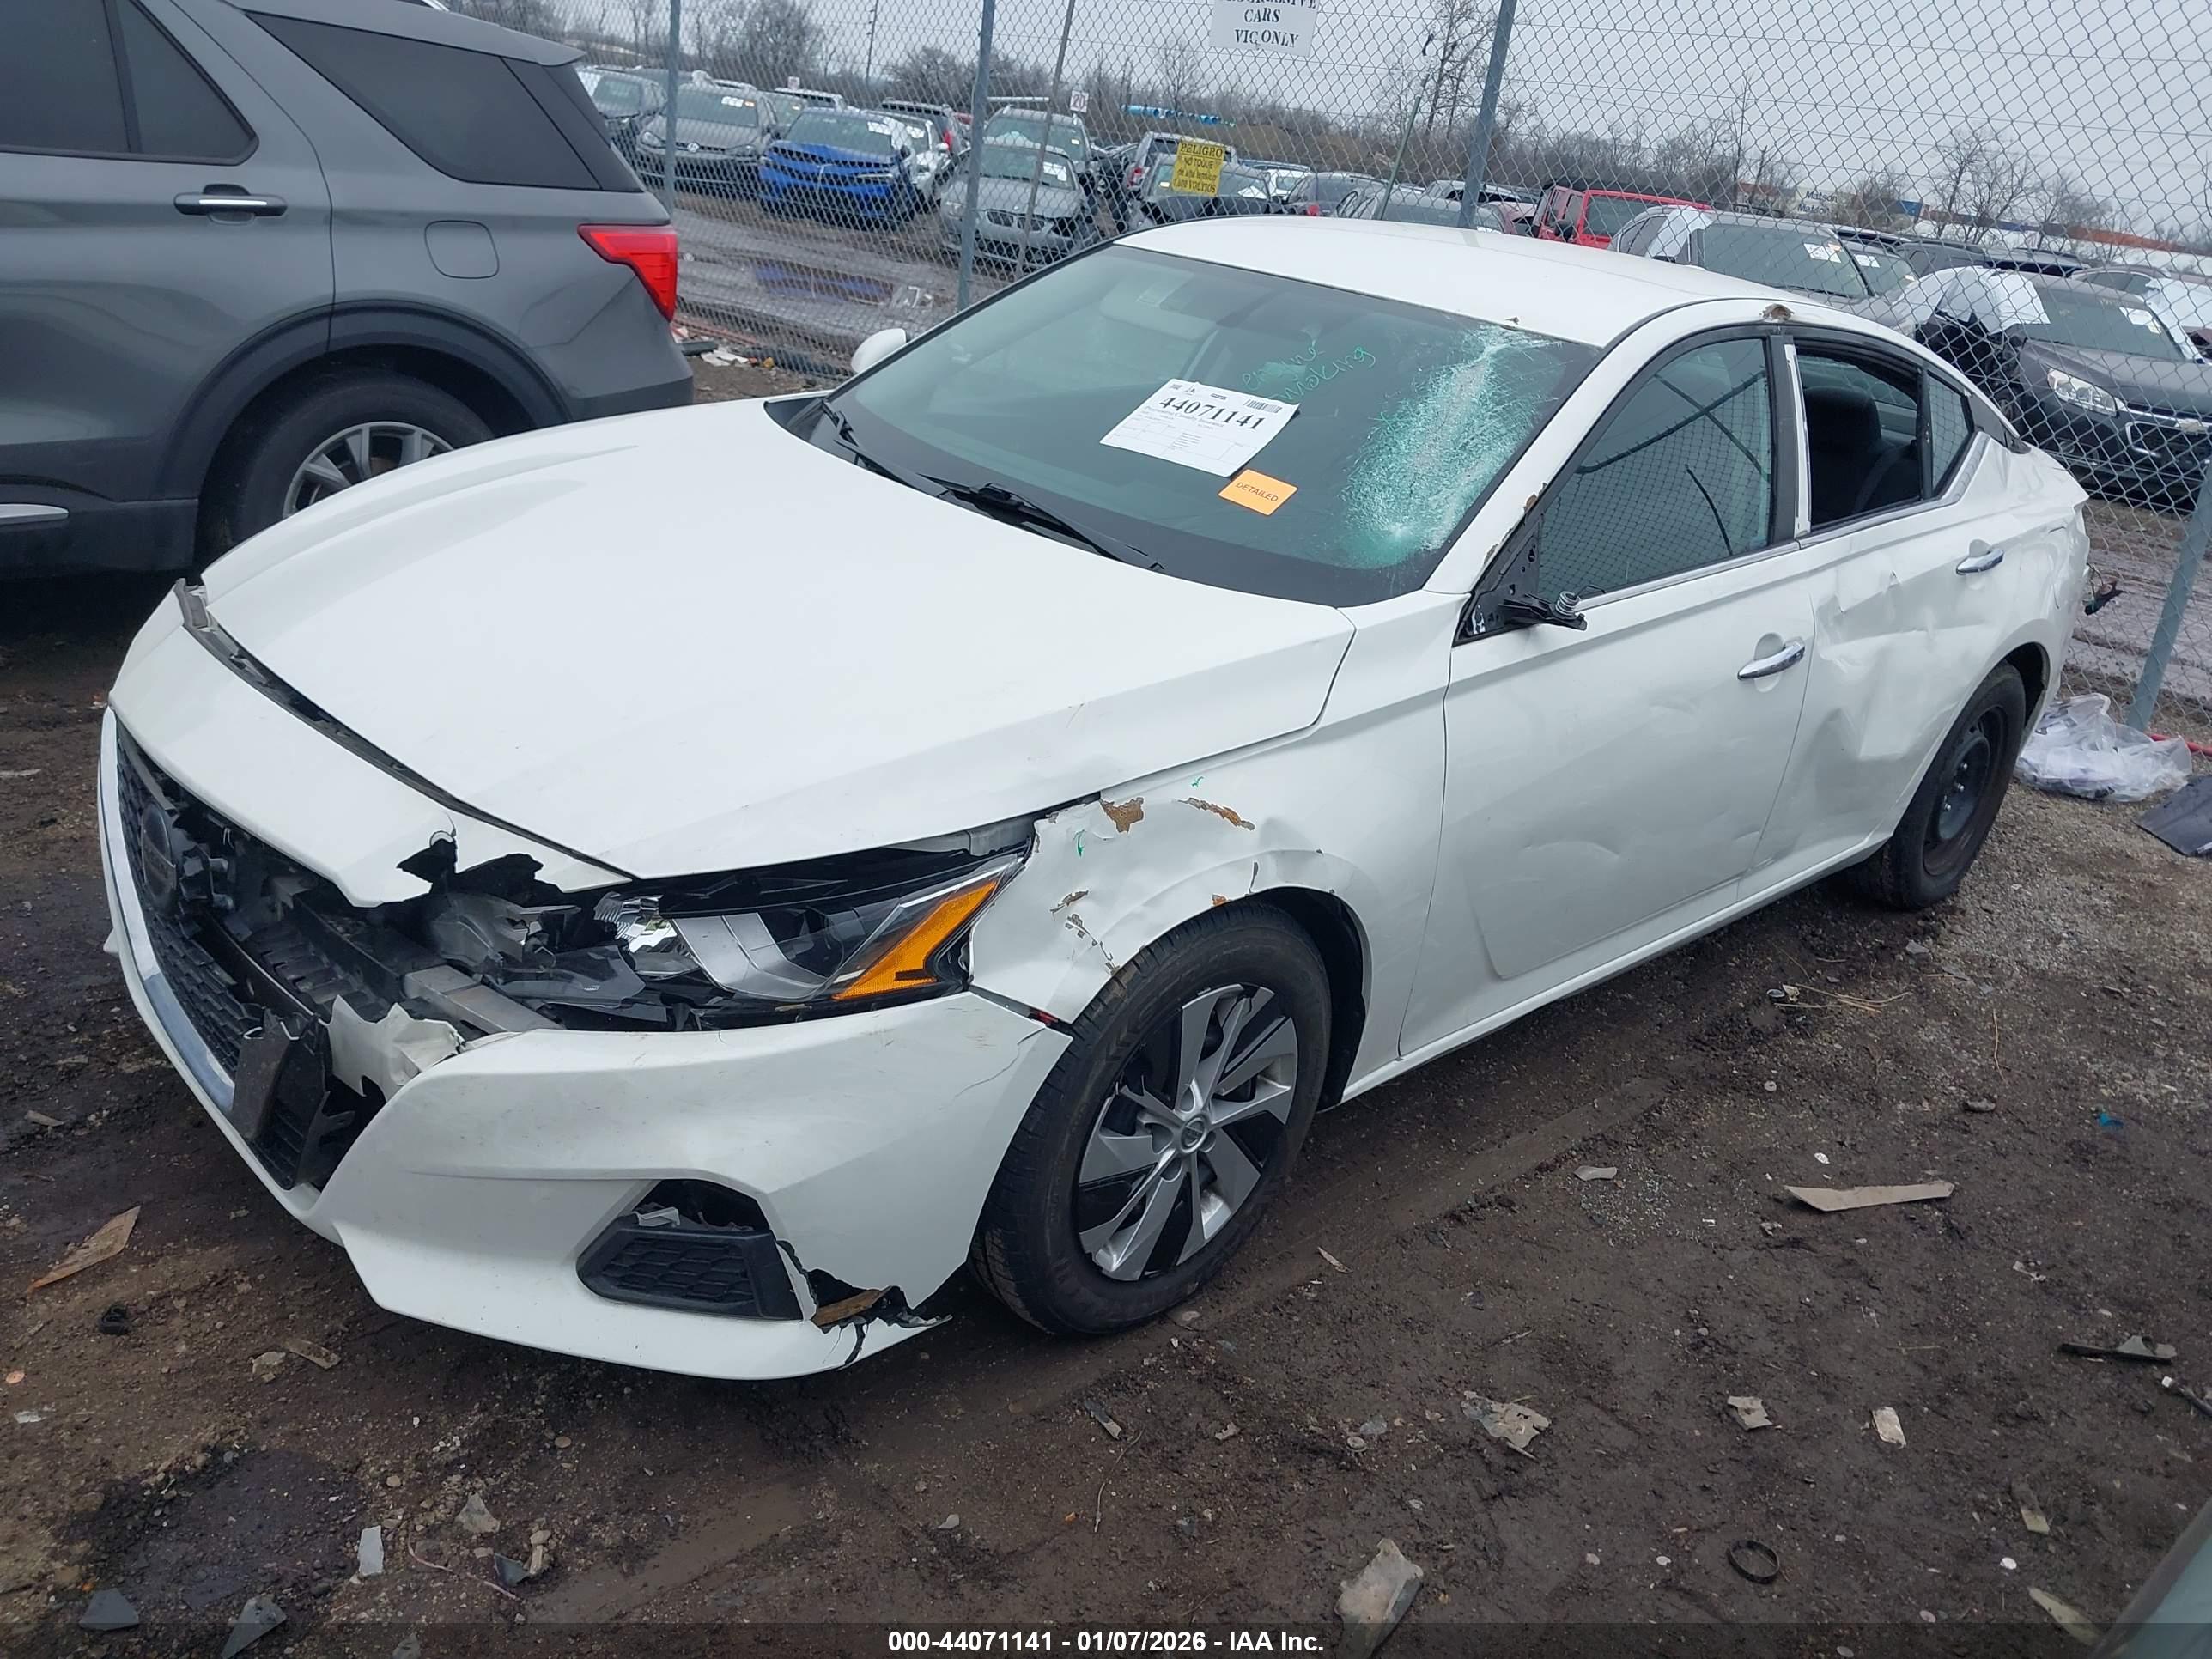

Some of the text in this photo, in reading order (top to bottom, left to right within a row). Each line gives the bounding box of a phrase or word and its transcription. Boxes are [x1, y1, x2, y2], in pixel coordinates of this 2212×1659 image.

[1244, 7, 1280, 23] CARS
[1235, 29, 1298, 48] VIC ONLY
[1073, 94, 1086, 109] 20
[1180, 143, 1223, 157] PELIGRO
[1159, 397, 1265, 430] 44071141
[1236, 482, 1279, 502] DETAILED
